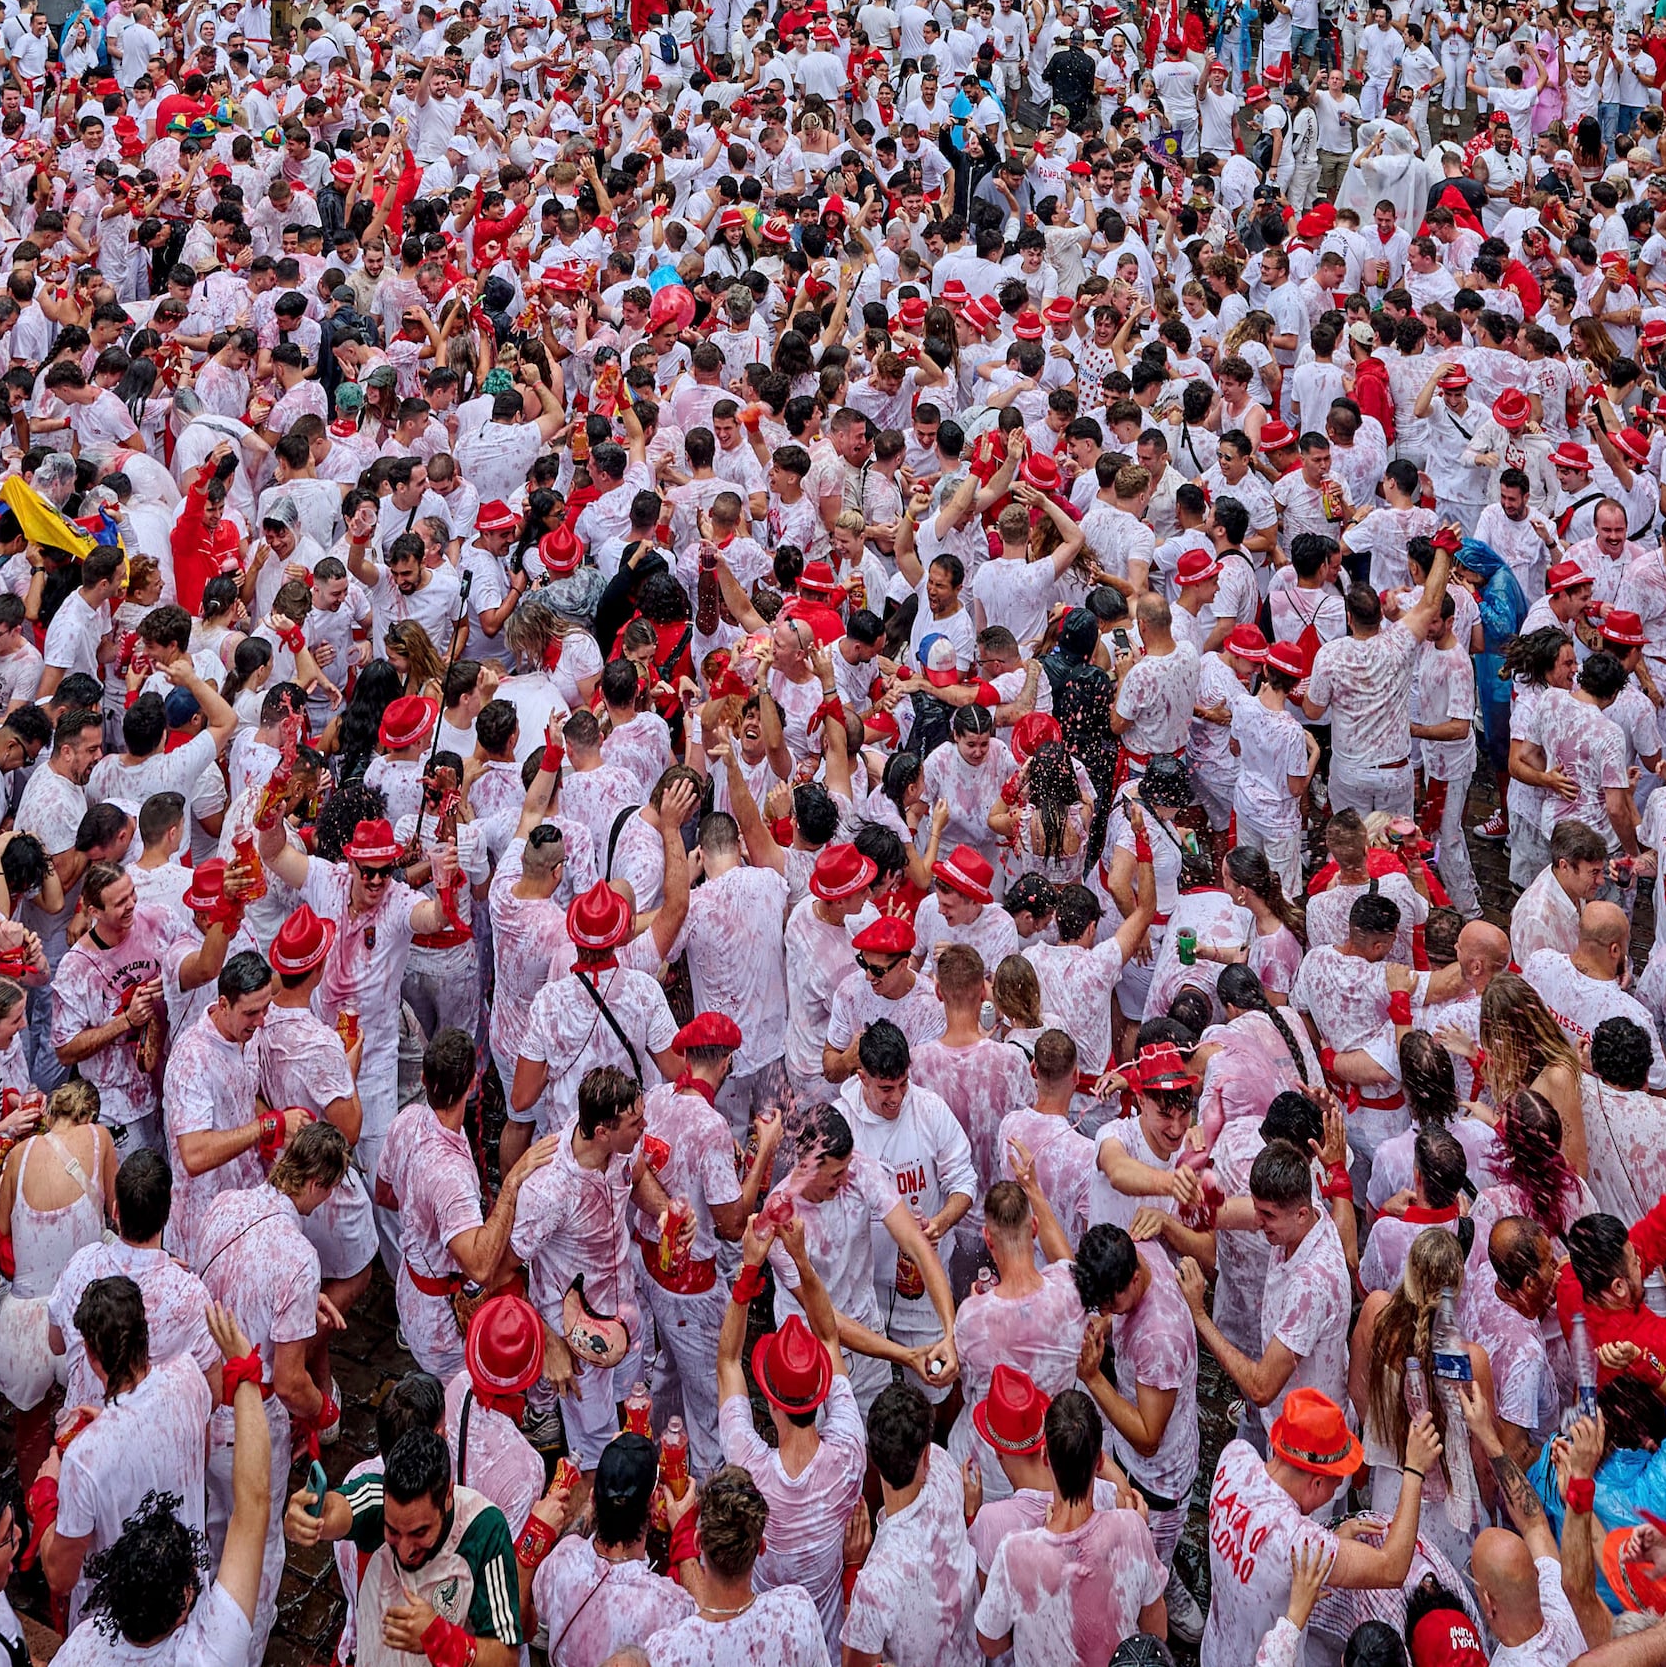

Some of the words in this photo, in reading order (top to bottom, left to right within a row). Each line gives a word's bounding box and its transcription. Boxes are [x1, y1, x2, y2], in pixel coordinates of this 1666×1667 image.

[108, 961, 151, 990] PAMPLONA
[1208, 1508, 1256, 1585] PLOMO
[1214, 1466, 1252, 1546] PLATA
[1249, 1526, 1267, 1554] O
